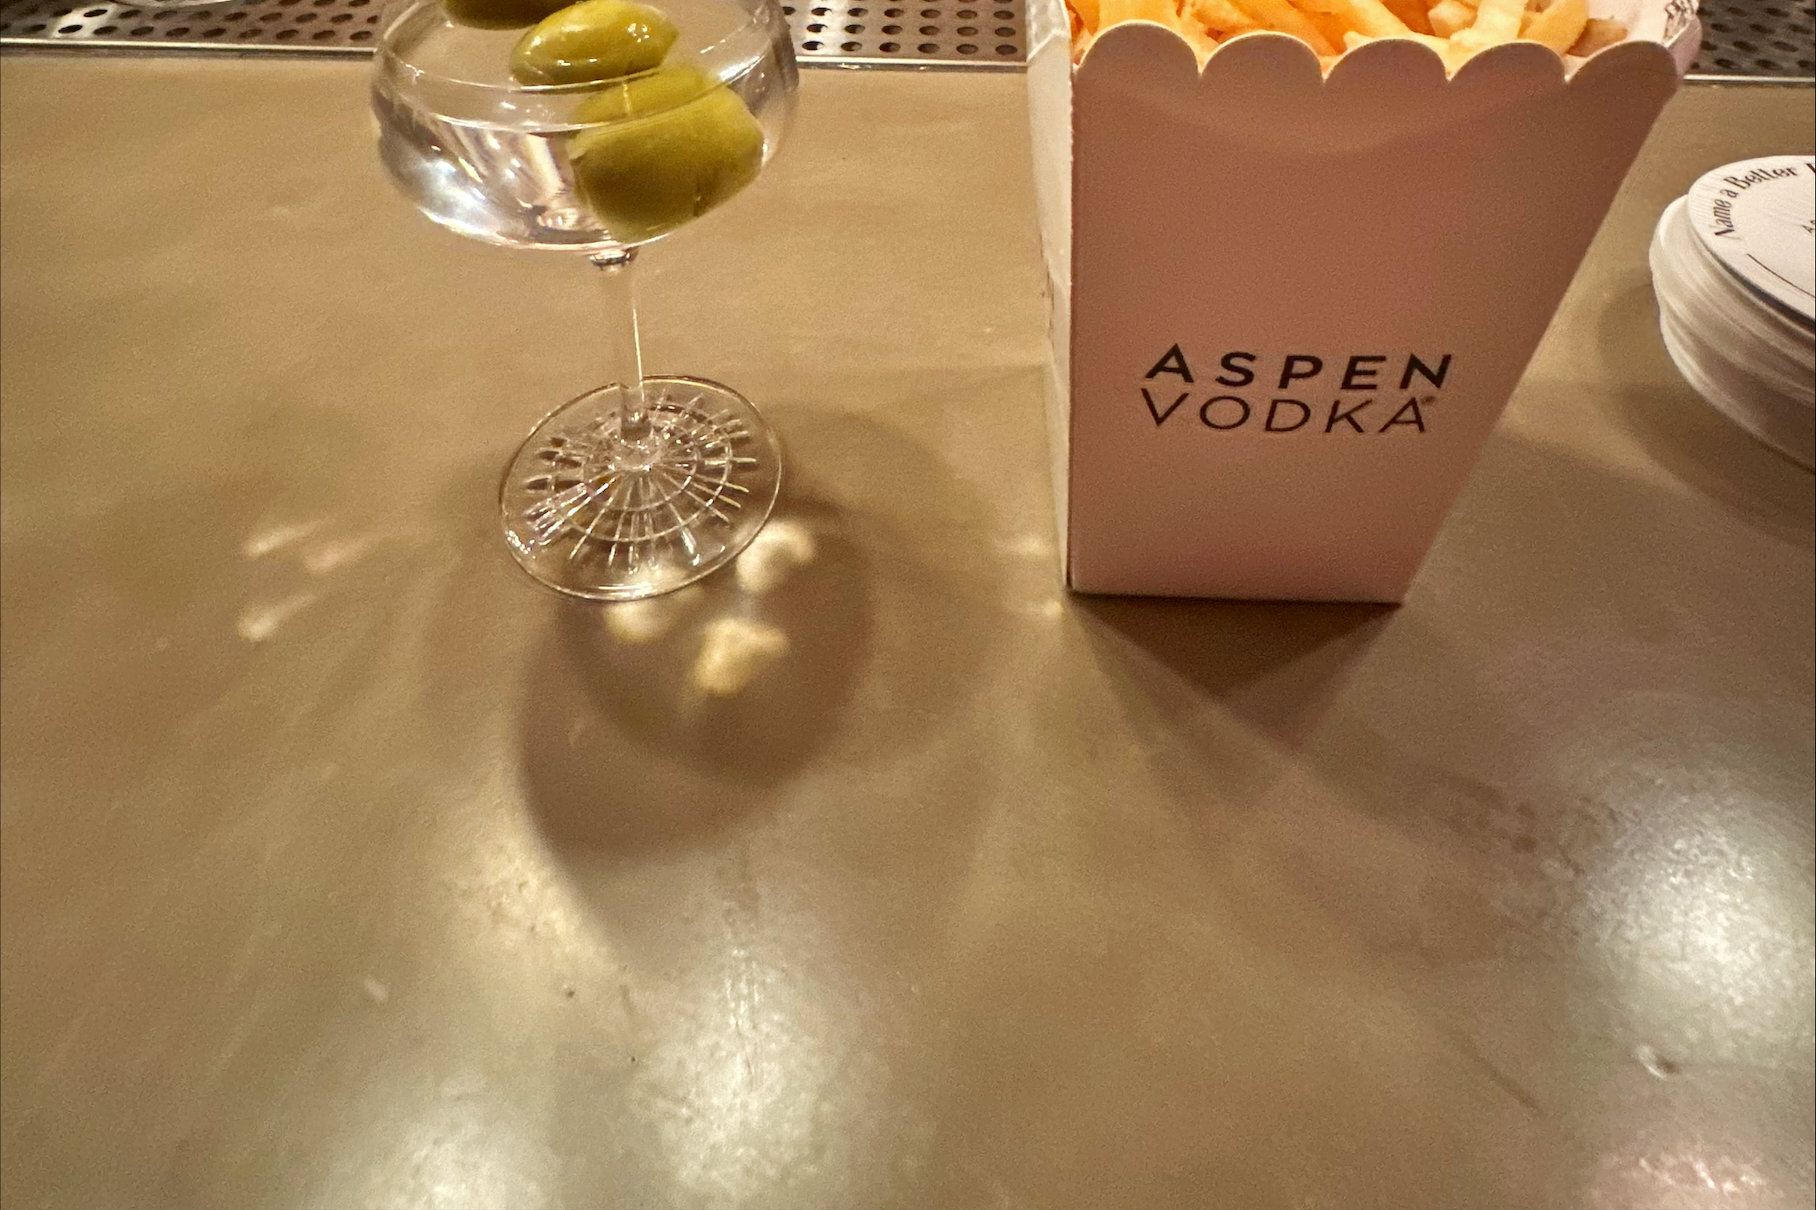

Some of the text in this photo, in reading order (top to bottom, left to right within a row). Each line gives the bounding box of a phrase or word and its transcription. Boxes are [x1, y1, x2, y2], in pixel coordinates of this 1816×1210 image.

[1711, 167, 1799, 241] Name a Better
[1144, 342, 1453, 390] ASPEN
[1141, 387, 1427, 434] VODKA
